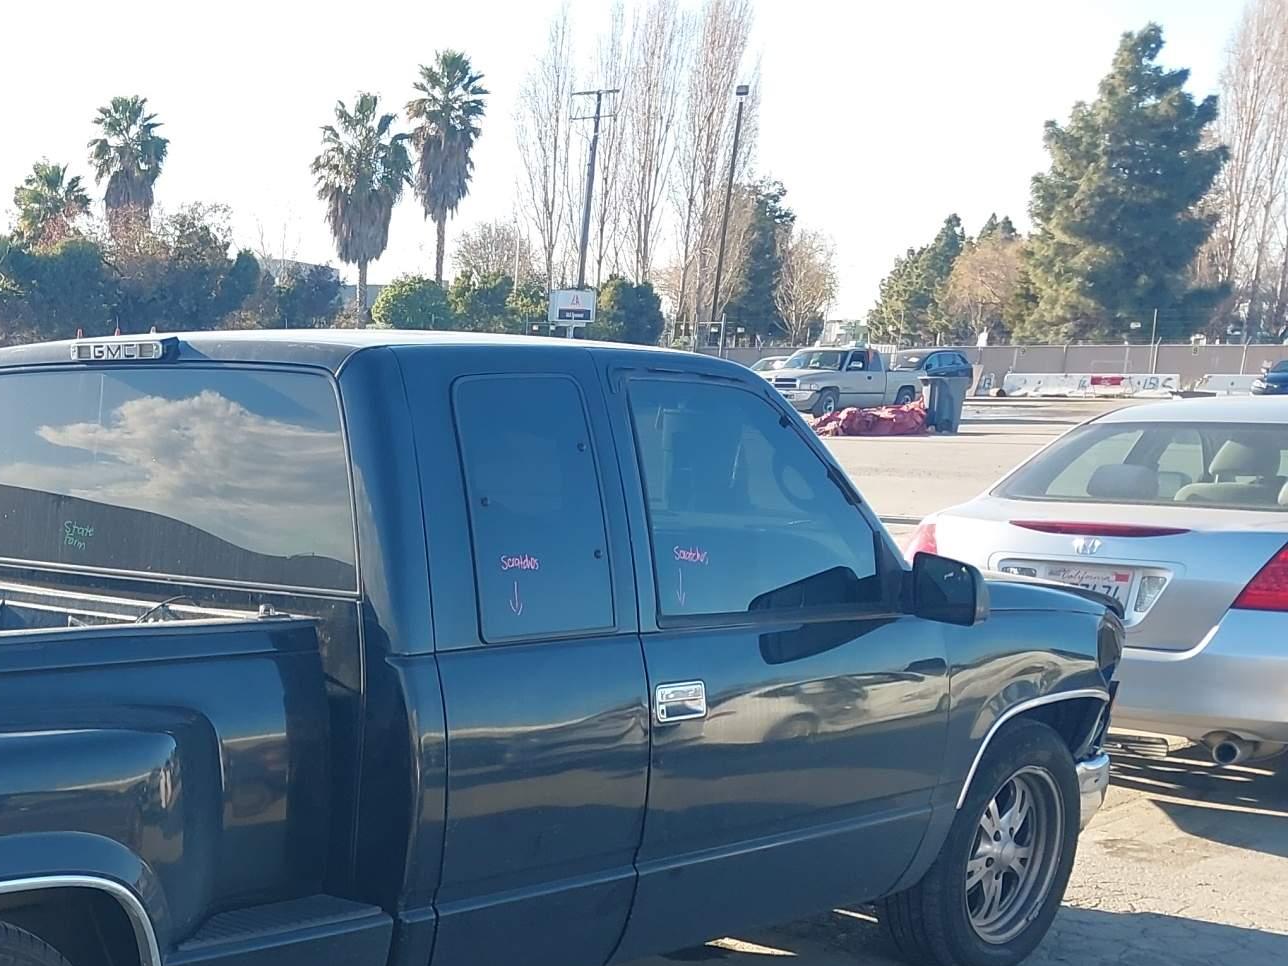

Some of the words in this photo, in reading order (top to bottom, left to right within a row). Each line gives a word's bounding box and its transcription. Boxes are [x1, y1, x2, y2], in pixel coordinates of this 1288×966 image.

[94, 344, 135, 359] GMC
[64, 520, 94, 536] State
[1061, 568, 1111, 582] California
